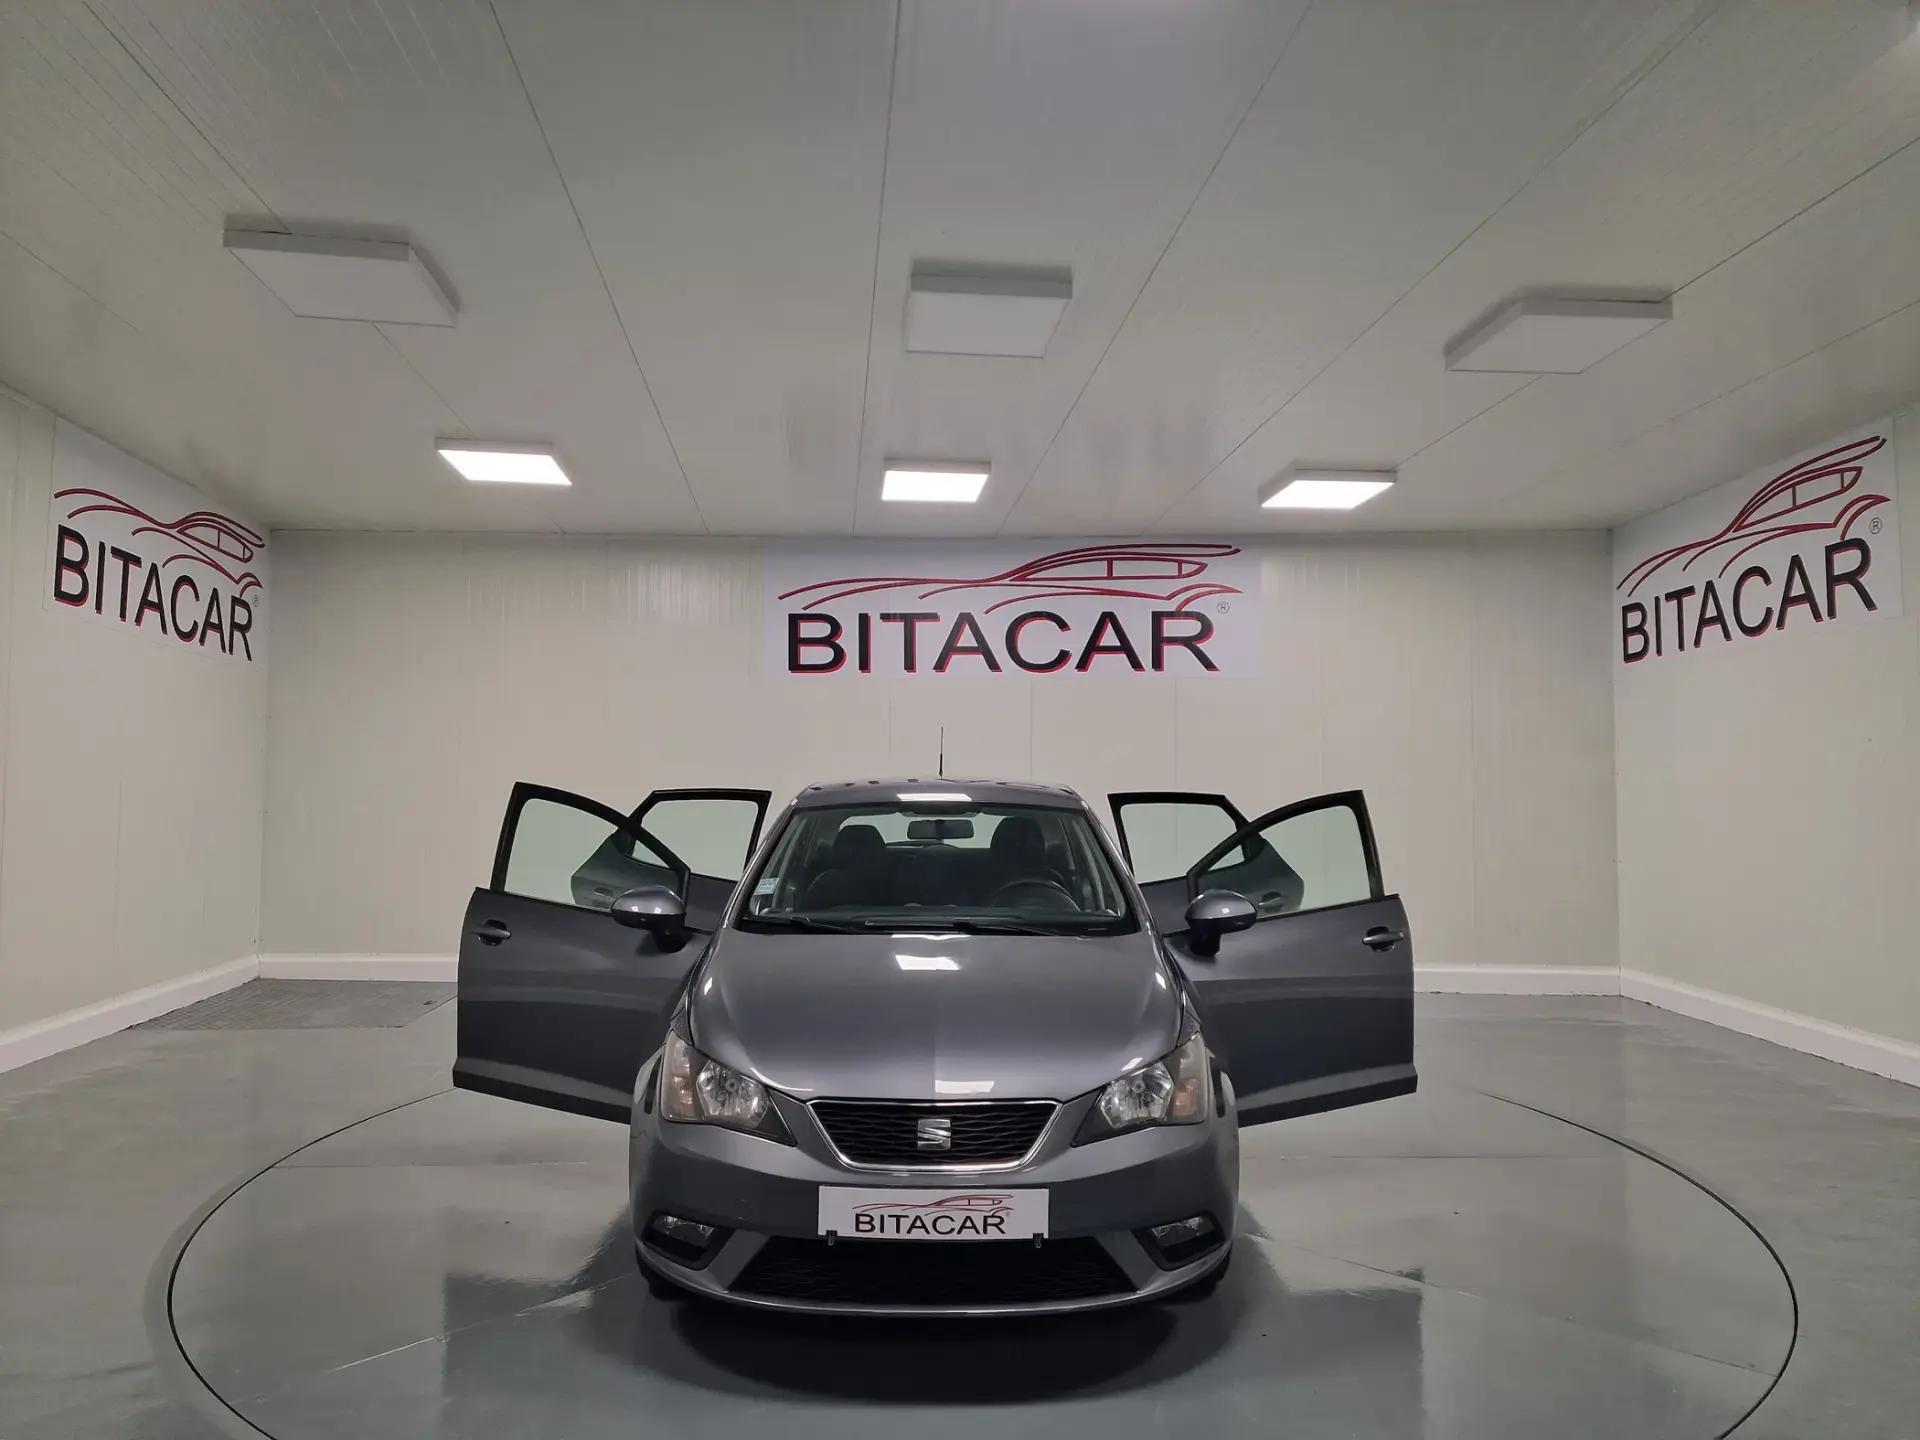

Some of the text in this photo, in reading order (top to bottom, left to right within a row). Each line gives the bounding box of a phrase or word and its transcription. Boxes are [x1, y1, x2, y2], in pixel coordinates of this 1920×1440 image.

[53, 524, 252, 661] BITACAR
[1621, 537, 1877, 663] BITACAR
[787, 611, 1220, 673] BITACAR
[854, 1213, 1006, 1235] BITACAR
